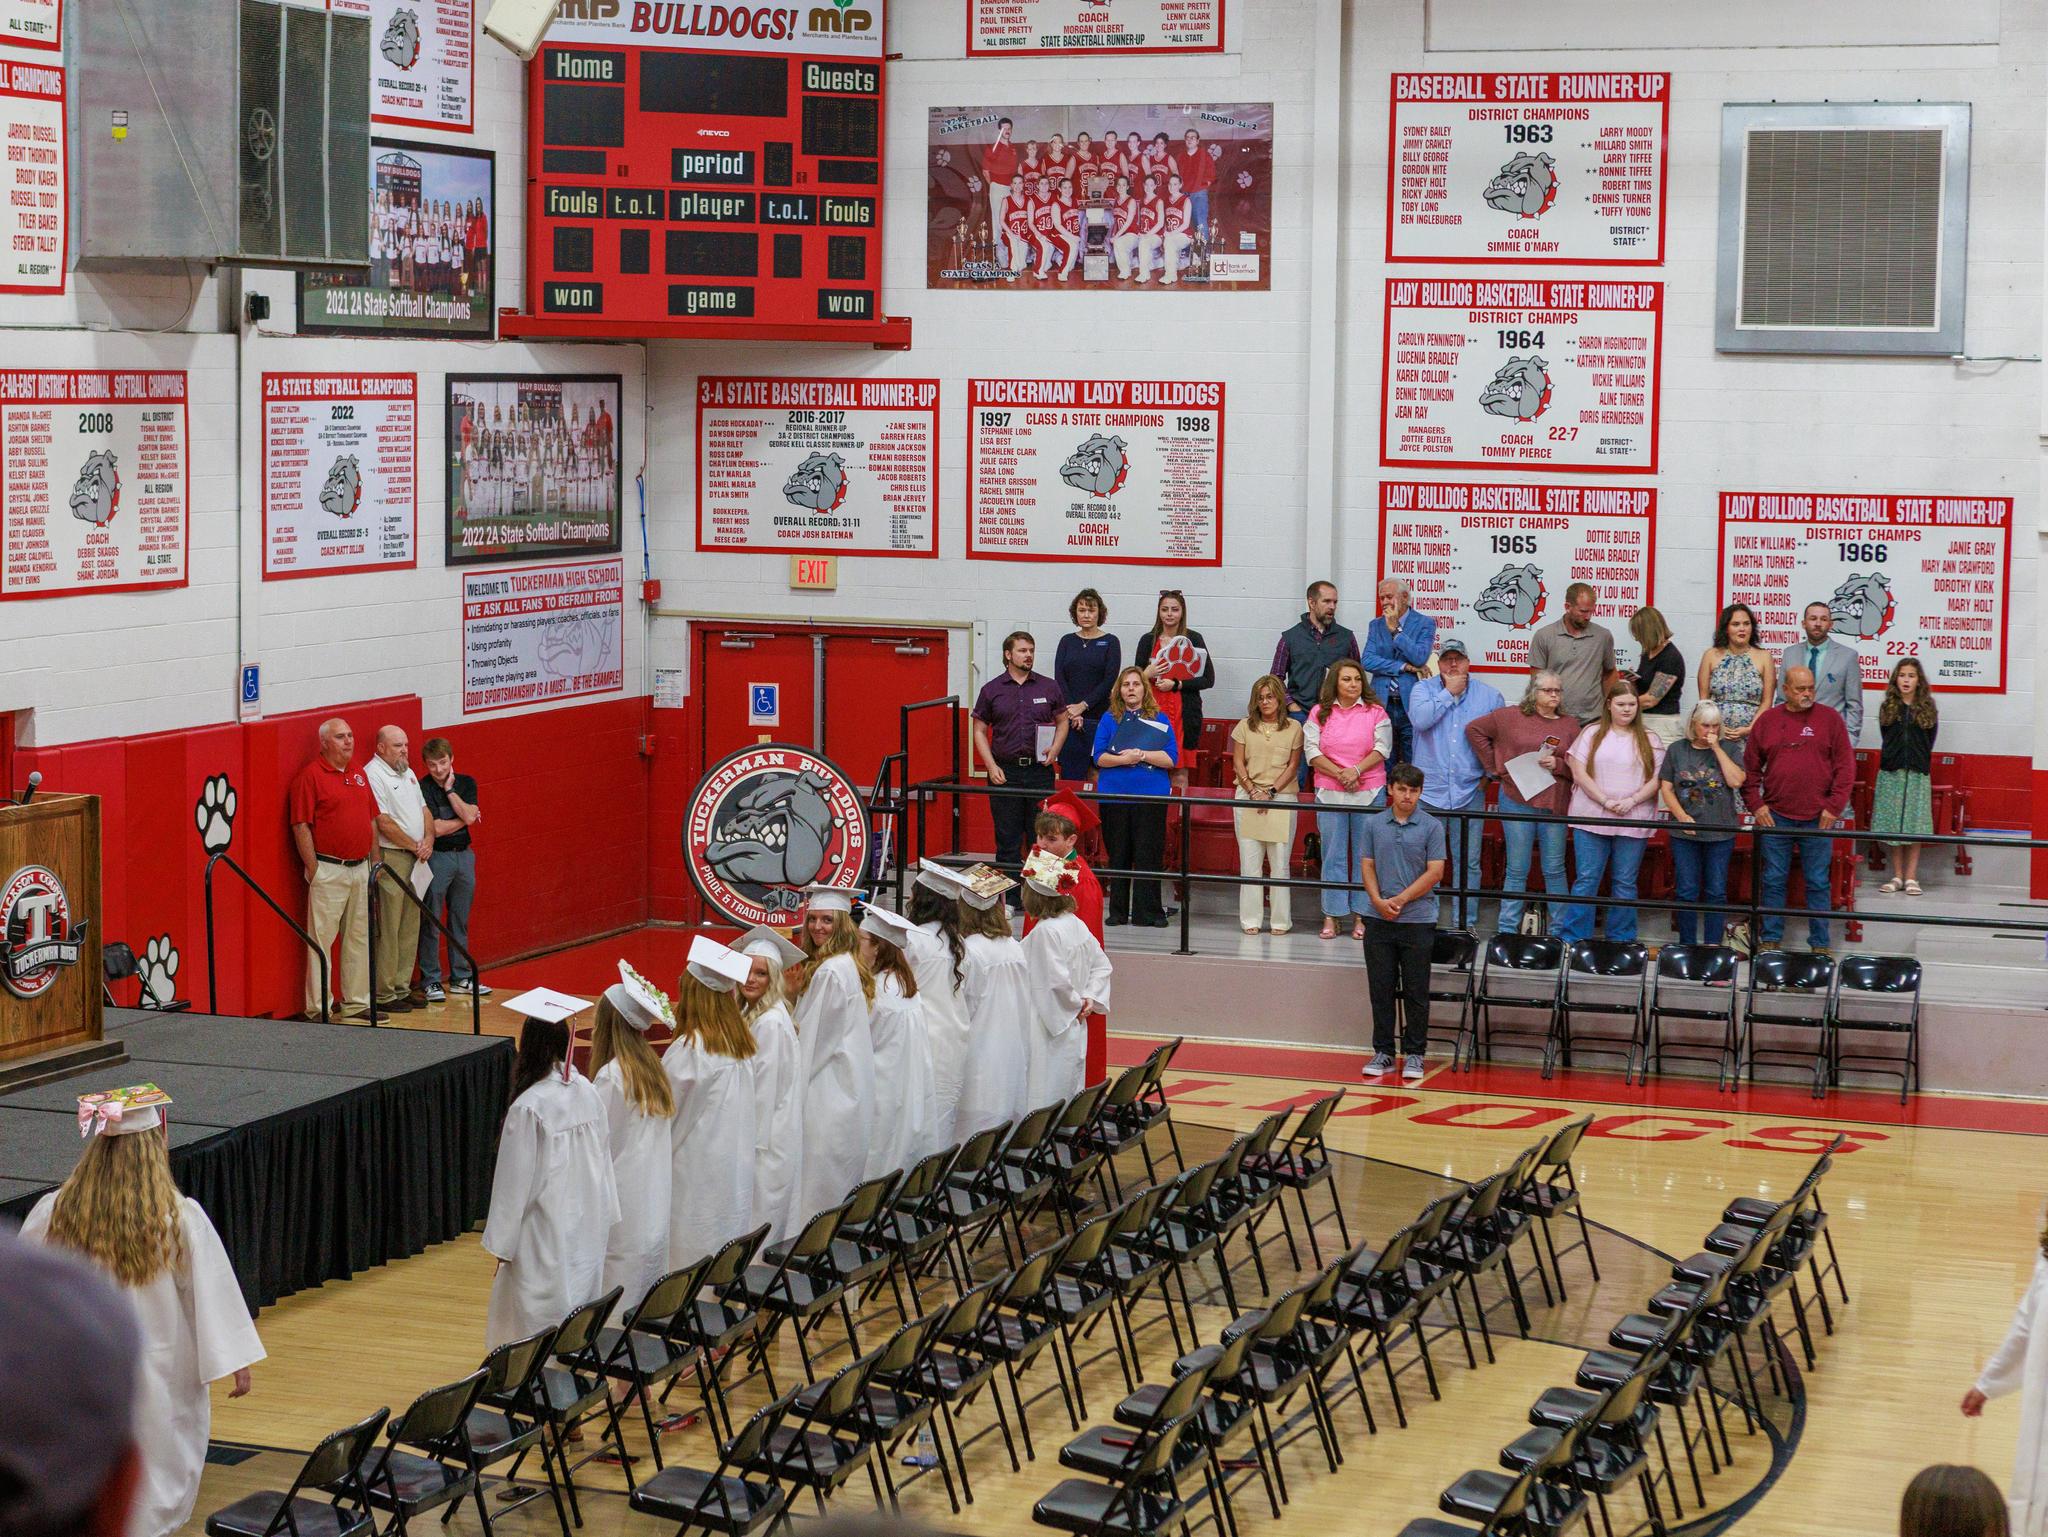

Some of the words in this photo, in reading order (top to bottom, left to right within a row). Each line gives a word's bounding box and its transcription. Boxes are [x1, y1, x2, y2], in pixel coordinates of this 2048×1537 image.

[630, 1, 798, 40] BULLDOGS!
[1078, 13, 1109, 23] COACH
[1040, 35, 1062, 47] STATE
[1063, 34, 1104, 47] BASKETBALL
[1106, 33, 1145, 46] RUNNER-UP
[556, 52, 613, 80] Home
[12, 66, 61, 95] CHAMPIONS
[807, 64, 875, 92] Guests
[1396, 75, 1486, 99] BASEBALL
[1495, 75, 1549, 99] STATE
[1558, 75, 1664, 98] RUNNER-UP
[1468, 109, 1518, 120] DISTRICT
[1523, 109, 1589, 121] CHAMPIONS
[1504, 124, 1553, 144] 1963
[682, 152, 744, 178] period
[551, 190, 598, 213] fouls
[1401, 190, 1423, 199] RICKY
[1424, 190, 1447, 200] JOHNS
[681, 193, 745, 218] player
[768, 200, 808, 220] t.o.l.
[825, 199, 869, 223] fouls
[19, 213, 36, 229] TYLER
[38, 214, 57, 231] BAKER
[1507, 229, 1539, 239] COACH
[1487, 242, 1521, 252] SIMMIE
[1524, 242, 1559, 252] O'MARY
[555, 287, 593, 307] won
[687, 289, 736, 314] game
[828, 294, 865, 313] won
[1391, 283, 1418, 305] LADY
[1424, 283, 1473, 306] BULLDOG
[1476, 283, 1545, 307] BASKETBALL
[1550, 284, 1584, 308] STATE
[1588, 285, 1654, 308] RUNNER-UP
[326, 290, 349, 315] 2021
[350, 291, 362, 315] 2A
[363, 292, 388, 317] State
[389, 293, 423, 319] Softball
[424, 295, 471, 324] Champions
[1469, 312, 1522, 324] DISTRICT
[1528, 313, 1578, 324] CHAMPS
[1497, 330, 1545, 349] 1964
[266, 379, 280, 396] 2A
[282, 379, 312, 395] STATE
[313, 379, 360, 395] SOFTBALL
[361, 378, 413, 395] CHAMPIONS
[701, 382, 723, 404] 3-A
[727, 382, 768, 405] STATE
[771, 382, 857, 406] BASKETBALL
[862, 384, 936, 407] RUNNER-UP
[975, 381, 1075, 404] TUCKERMAN
[1083, 382, 1125, 404] LADY
[1132, 383, 1220, 406] BULLDOGS
[331, 405, 354, 419] 2022
[980, 412, 1012, 427] 1997
[1026, 412, 1058, 425] CLASS
[1061, 413, 1068, 425] A
[1072, 413, 1101, 426] STATE
[1105, 414, 1164, 427] CHAMPIONS
[1395, 406, 1413, 418] JEAN
[1415, 406, 1429, 419] RAY
[79, 413, 113, 434] 2008
[1177, 416, 1210, 432] 1998
[1501, 434, 1534, 445] COACH
[1549, 426, 1579, 442] 22-7
[1481, 446, 1515, 457] TOMMY
[1519, 447, 1552, 458] PIERCE
[1386, 485, 1412, 508] LADY
[1417, 486, 1468, 510] BULLDOG
[1471, 487, 1541, 511] BASKETBALL
[1546, 489, 1580, 513] STATE
[1583, 490, 1650, 514] RUNNER-UP
[996, 508, 1017, 516] JONES
[1725, 495, 1755, 518] LADY
[1760, 496, 1812, 521] BULLDOG
[1816, 497, 1889, 522] BASKETBALL
[1896, 499, 1932, 523] STATE
[1936, 500, 2006, 525] RUNNER-UP
[773, 517, 807, 527] OVERALL
[808, 517, 840, 527] RECORD:
[1079, 523, 1109, 534] COACH
[1461, 516, 1514, 529] DISTRICT
[1519, 518, 1569, 530] CHAMPS
[86, 533, 109, 545] COACH
[462, 526, 485, 547] 2022
[486, 526, 499, 545] 2A
[501, 524, 523, 543] State
[526, 520, 559, 542] Softball
[561, 519, 609, 542] Champions
[777, 530, 800, 538] COACH
[802, 530, 819, 539] JOSH
[821, 531, 853, 539] BATEMAN
[1067, 535, 1094, 546] ALVIN
[1095, 535, 1119, 547] RILEY
[1806, 527, 1863, 540] DISTRICT
[1868, 529, 1921, 541] CHAMPS
[1490, 535, 1537, 554] 1965
[1838, 542, 1888, 563] 1966
[798, 559, 828, 584] EXIT
[467, 582, 499, 596] WELCOME
[501, 581, 509, 593] TO
[510, 572, 564, 592] TUCKERMAN
[566, 571, 586, 587] HIGH
[588, 567, 620, 584] SCHOOL
[1934, 579, 1971, 592] DOROTHY
[1974, 580, 1994, 594] KIRK
[467, 605, 481, 617] WE
[483, 603, 502, 615] ASK
[503, 601, 520, 614] ALL
[521, 598, 543, 612] FANS
[545, 597, 557, 609] TO
[558, 593, 594, 608] REFRAIN
[595, 590, 620, 604] FROM:
[1948, 598, 1971, 611] MARY
[1975, 599, 1993, 613] HOLT
[471, 619, 502, 634] Intimidating
[510, 617, 536, 631] harassing
[608, 608, 619, 617] fans
[471, 643, 487, 653] Using
[487, 639, 512, 651] profanity
[1497, 640, 1529, 650] COACH
[1886, 641, 1919, 656] 22-2
[472, 658, 497, 669] Throwing
[498, 654, 519, 666] Objects
[1485, 651, 1508, 662] WILL
[471, 674, 494, 686] Entering
[495, 673, 505, 682] the
[505, 671, 525, 683] playing
[466, 690, 483, 707] GOOD
[484, 684, 536, 704] SPORTSMANSHIP
[537, 683, 543, 695] IS
[573, 677, 582, 690] BE
[582, 675, 592, 688] THE
[693, 753, 785, 847] TUCKERMAN
[701, 865, 723, 897] PRIDE
[730, 900, 786, 924] TRADITION
